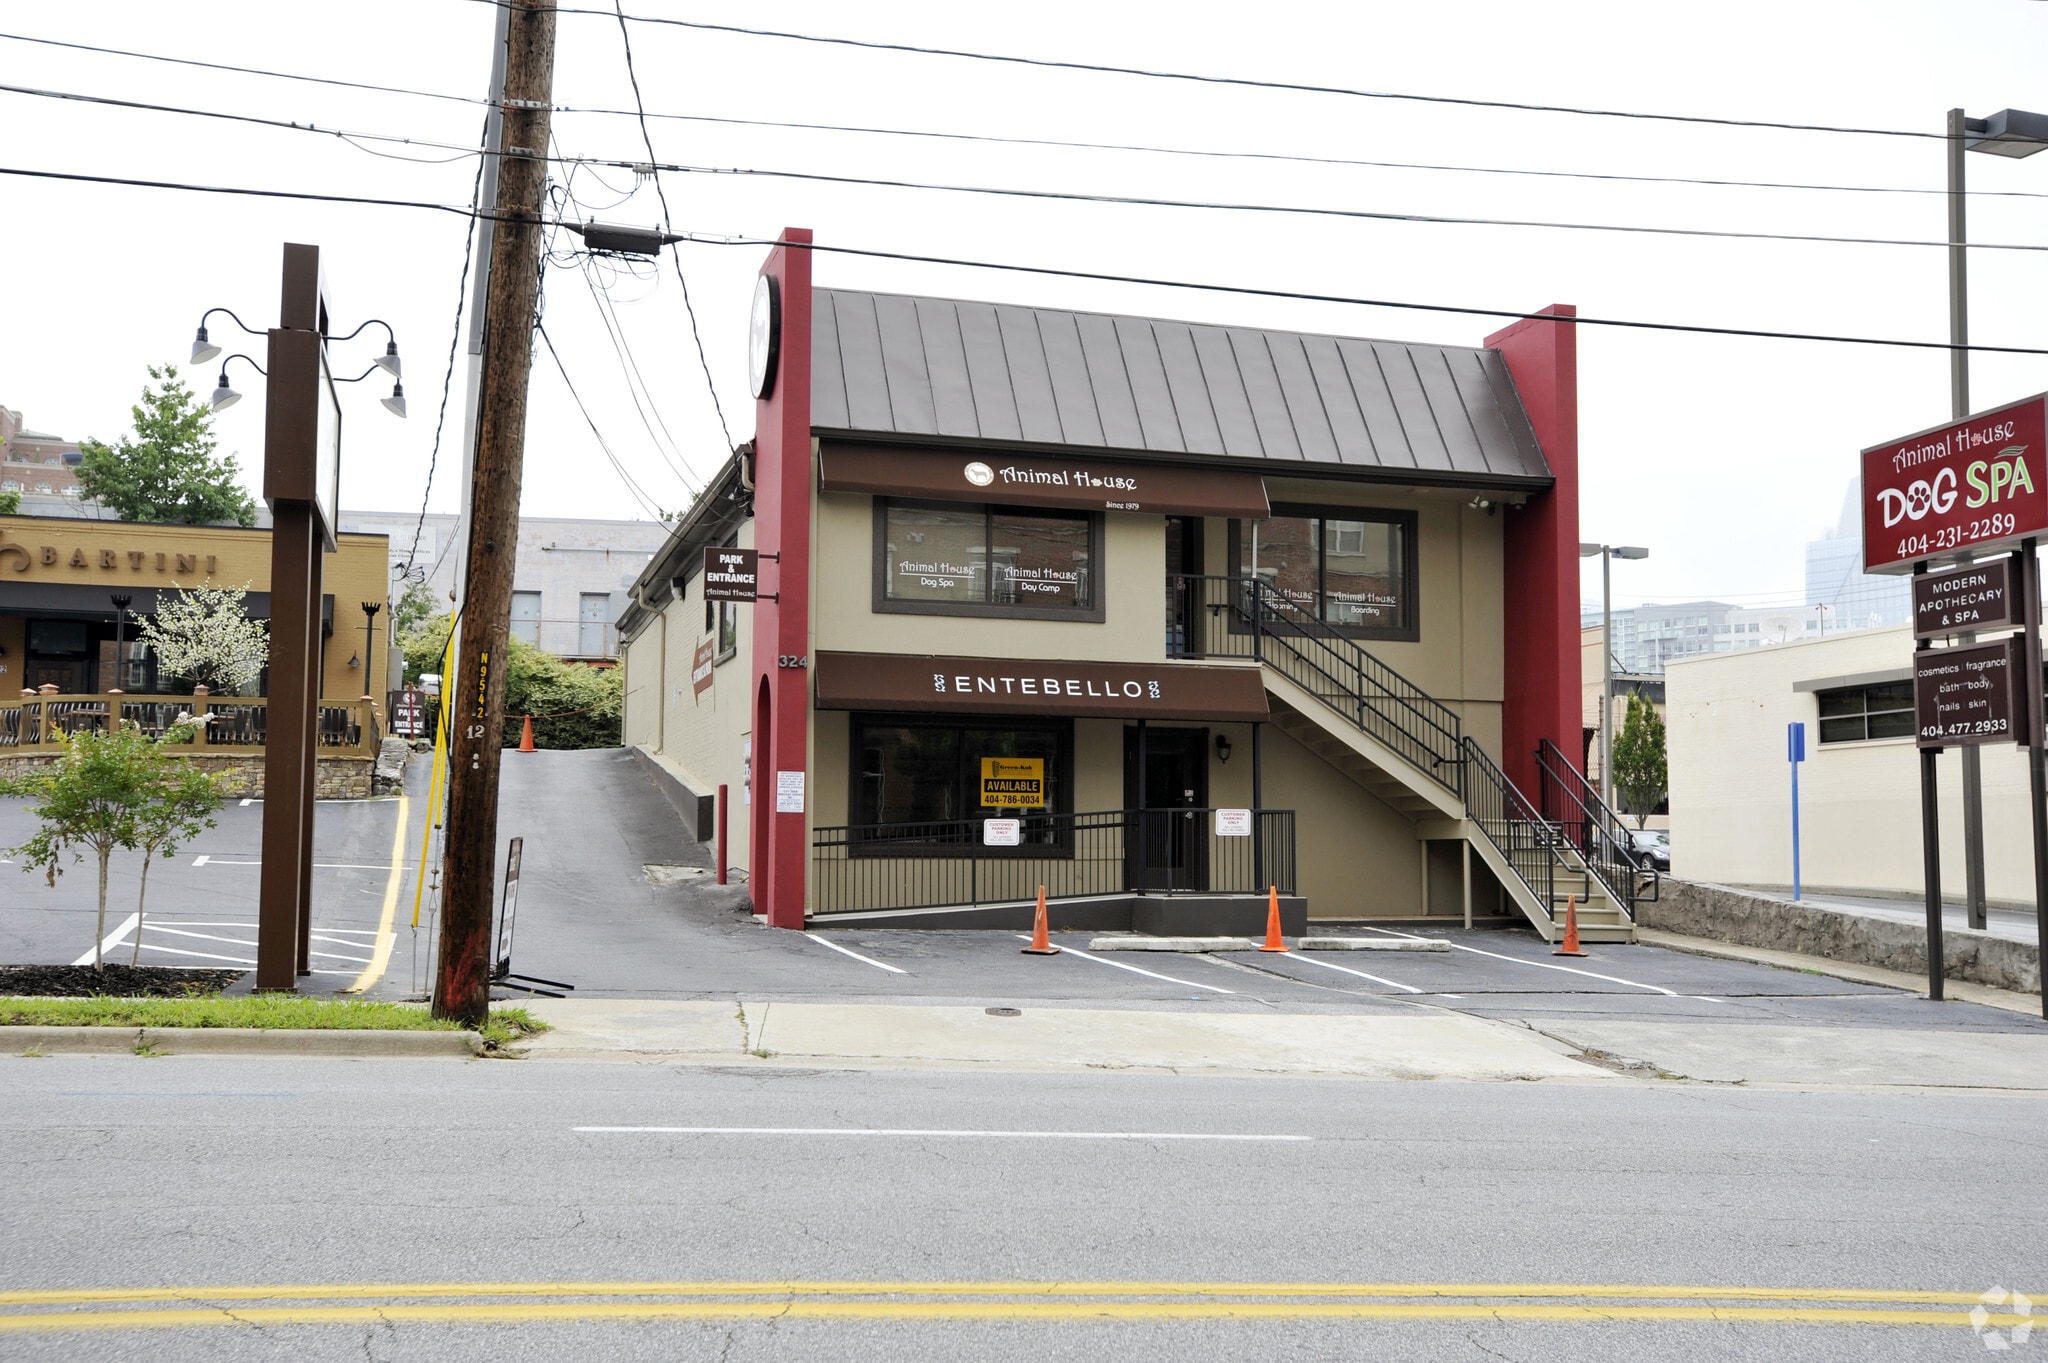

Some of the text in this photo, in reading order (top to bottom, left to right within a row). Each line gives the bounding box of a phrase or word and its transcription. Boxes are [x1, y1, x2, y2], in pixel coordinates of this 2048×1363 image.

[1892, 434, 1951, 473] Animal
[1000, 466, 1069, 486] Animal
[1876, 467, 1958, 528] DOG
[1105, 501, 1140, 510] Since 1979
[1896, 513, 2015, 558] 404-231-2289
[40, 545, 217, 574] BARTINI
[719, 554, 743, 564] PARK
[727, 564, 735, 573] &
[899, 560, 938, 573] Animal
[1004, 566, 1041, 578] Animal
[707, 572, 755, 584] ENTRANCE
[920, 577, 954, 588] Dog Spa
[1932, 574, 1987, 594] MODERN
[706, 587, 732, 597] Animal
[1021, 582, 1060, 593] Day Camp
[1333, 591, 1366, 602] Animal
[1918, 588, 2003, 613] APOTHECARY
[1350, 606, 1380, 616] Boarding
[1941, 609, 1980, 625] & SPA
[778, 655, 808, 668] 324
[1918, 658, 2007, 677] cosmetics fragrance
[954, 676, 1142, 698] ENTEBELLO
[1939, 680, 1990, 693] bath body
[1939, 698, 1987, 712] nails skin
[466, 725, 485, 739] 12
[1921, 718, 2008, 737] 404.477.2933
[986, 780, 1038, 791] AVAILABLE
[984, 795, 1040, 804] 404-786-0034
